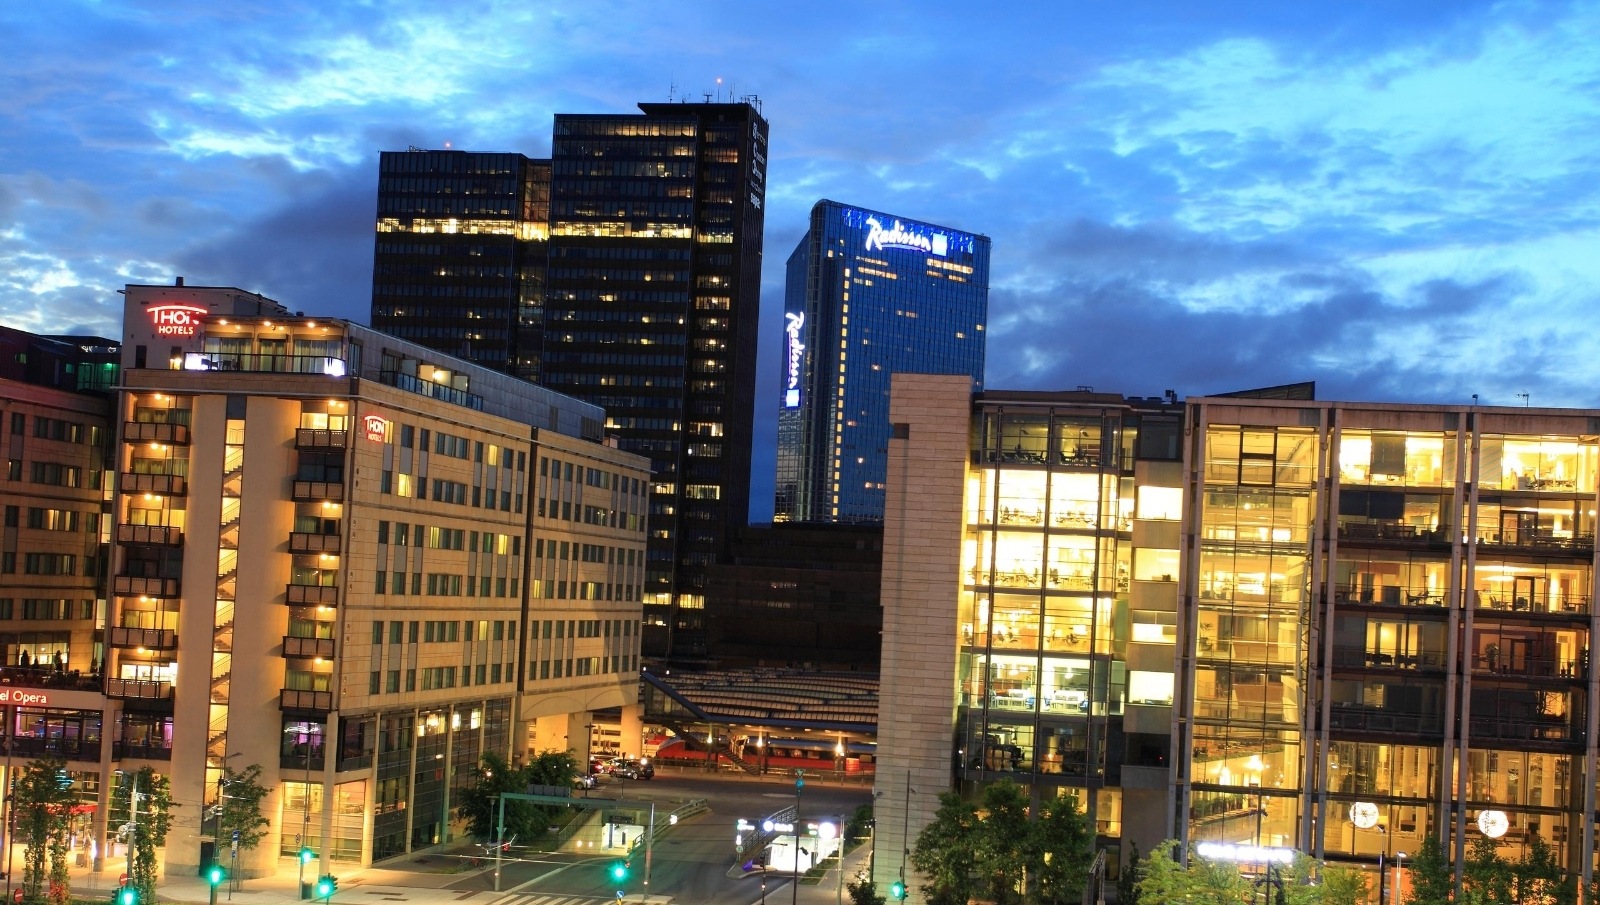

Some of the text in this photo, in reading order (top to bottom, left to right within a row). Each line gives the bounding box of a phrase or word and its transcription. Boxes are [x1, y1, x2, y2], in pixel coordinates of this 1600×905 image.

[866, 218, 931, 251] Radisson
[158, 325, 194, 334] HOTELS
[785, 311, 805, 389] Radisson
[364, 415, 386, 434] THON
[13, 690, 47, 705] Opera
